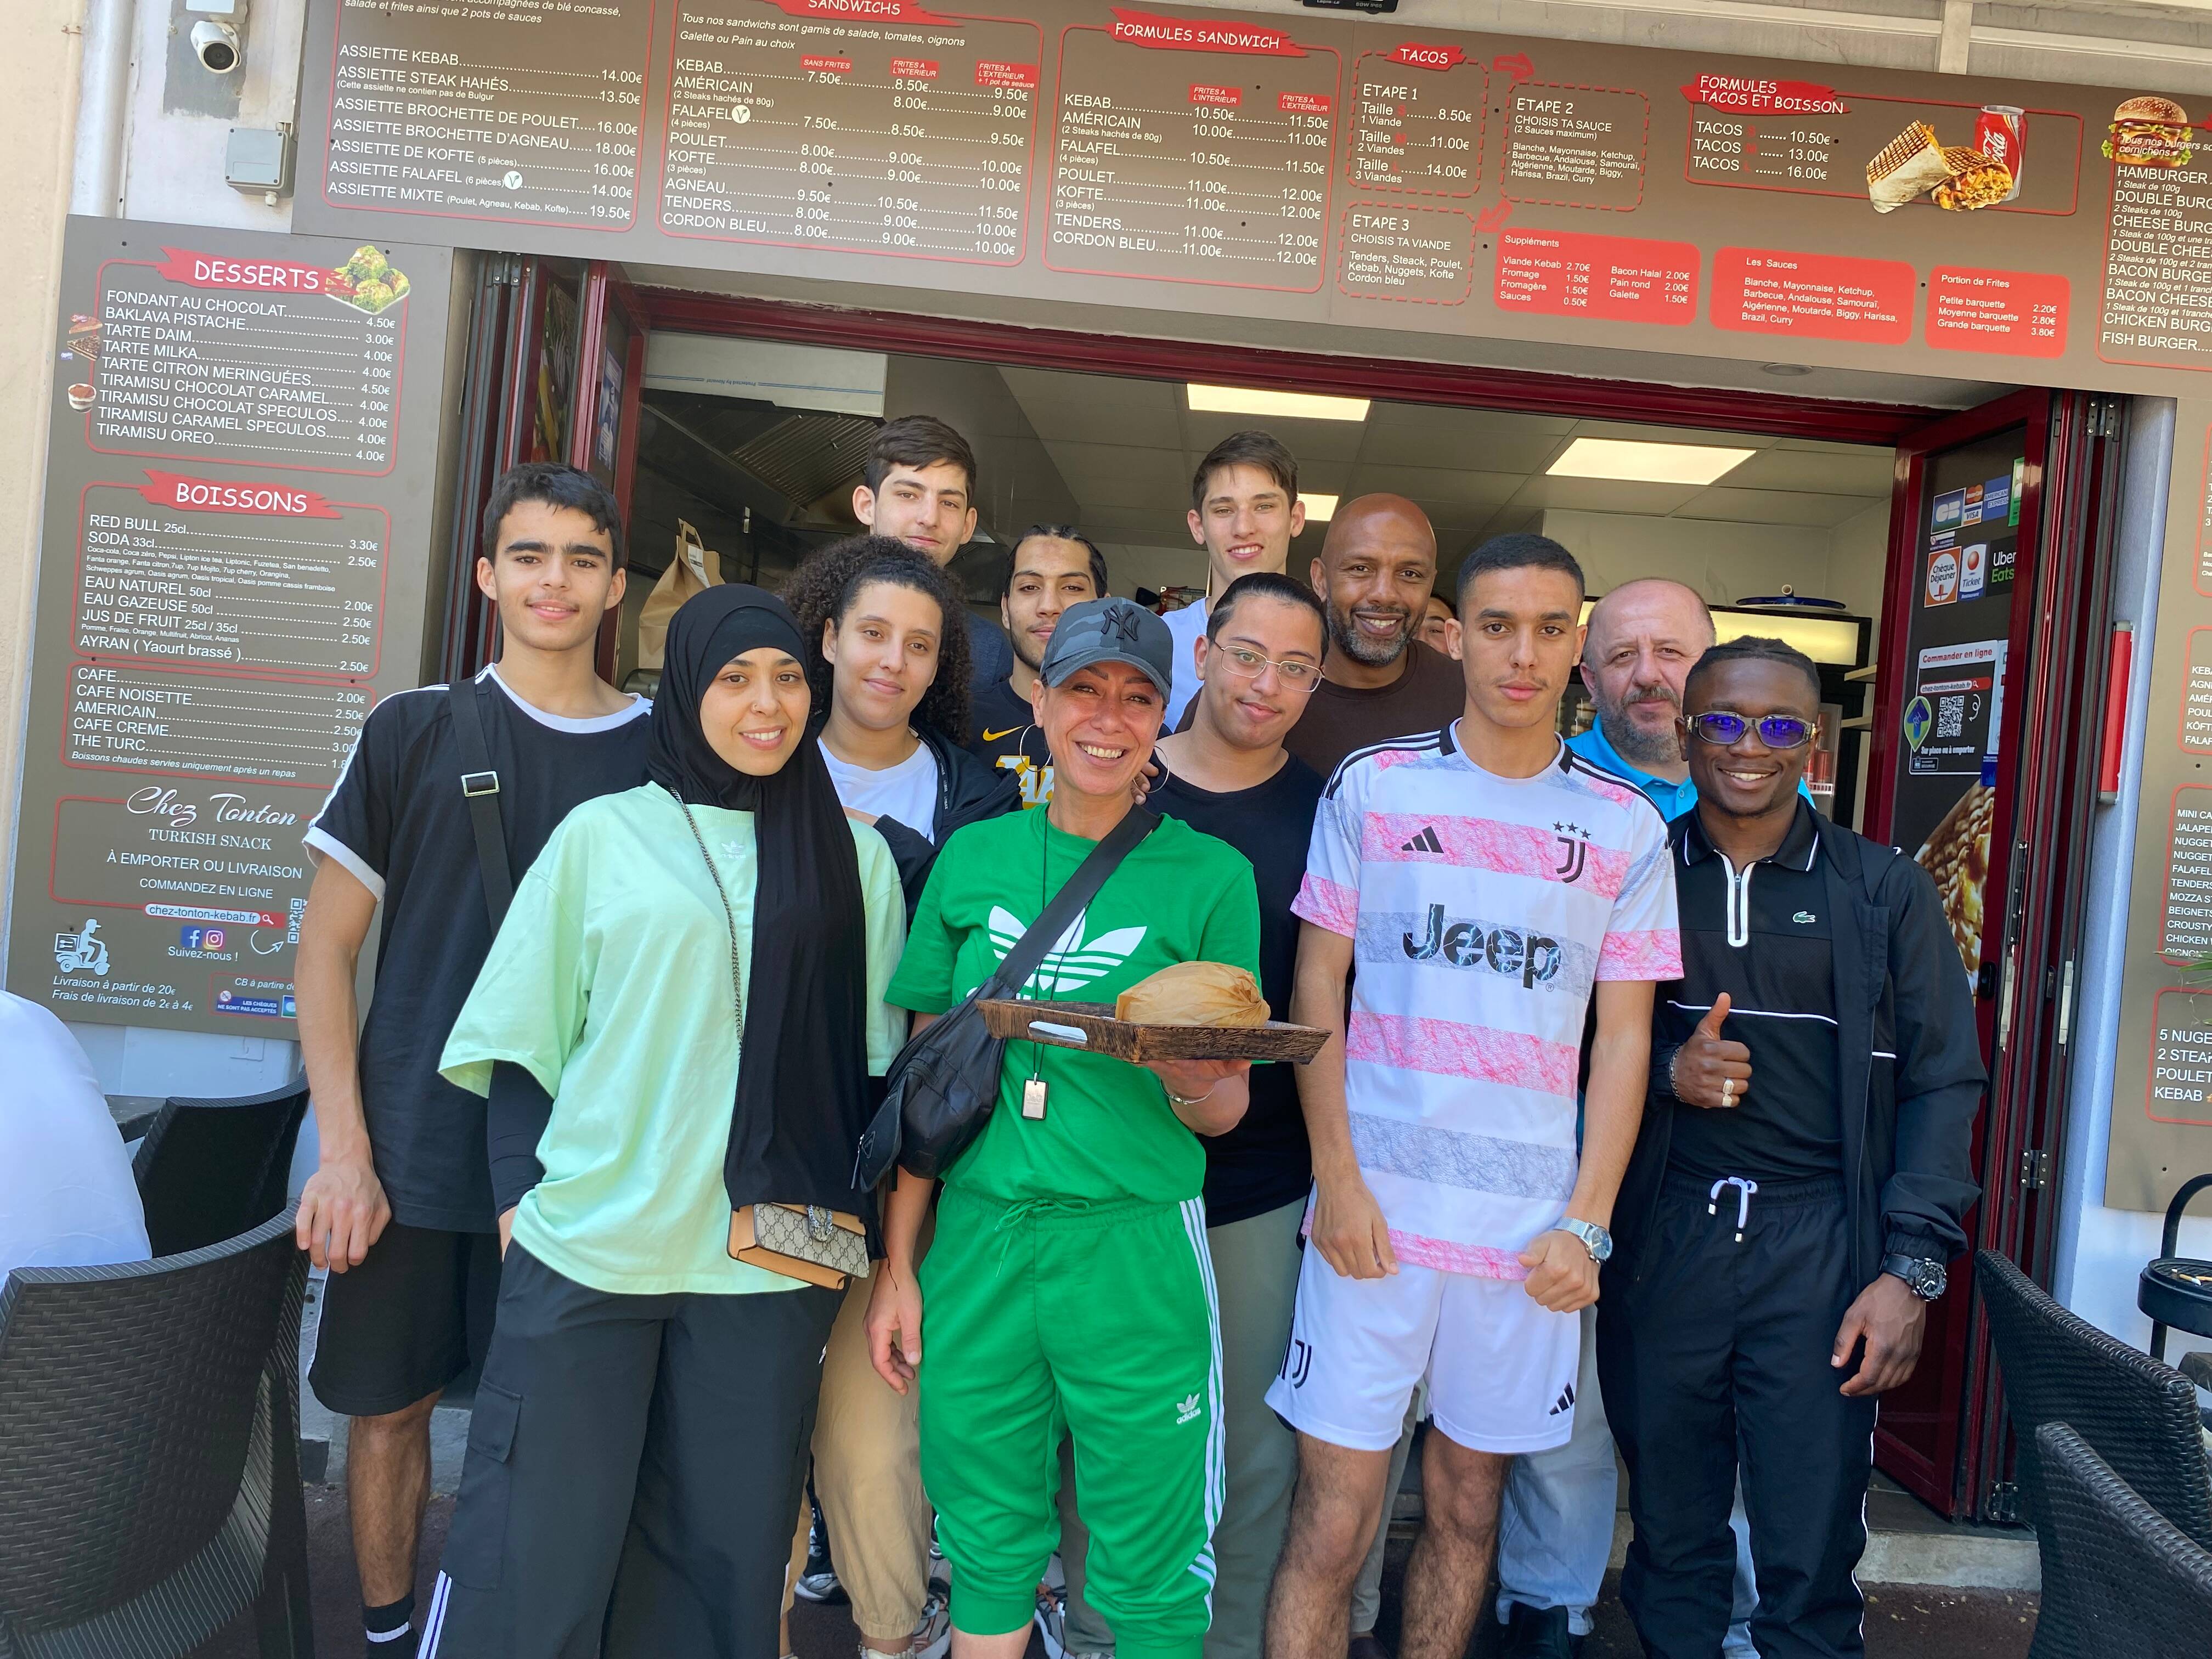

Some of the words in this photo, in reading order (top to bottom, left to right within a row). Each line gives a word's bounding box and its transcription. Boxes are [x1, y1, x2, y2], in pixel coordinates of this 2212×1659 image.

[682, 13, 704, 24] Tous
[706, 17, 724, 25] nos
[726, 19, 776, 30] sandwichs
[778, 24, 799, 32] sont
[833, 26, 845, 36] de
[847, 29, 881, 40] salade,
[884, 31, 924, 44] tomates,
[927, 36, 966, 46] oignons
[1115, 22, 1193, 41] FORMULES
[1197, 31, 1279, 49] SANDWICH
[339, 44, 408, 61] ASSIETTE
[412, 50, 459, 65] KEBAB
[602, 69, 642, 84] 14.00€
[803, 59, 823, 67] SANS
[825, 61, 851, 69] FRITES
[1400, 48, 1448, 64] TACOS
[410, 71, 456, 87] STEAK
[674, 75, 753, 94] AMÉRICAIN
[1700, 75, 1777, 94] FORMULES
[337, 80, 362, 89] (Cette
[364, 83, 394, 92] assiette
[408, 87, 437, 95] contien
[455, 90, 466, 98] de
[468, 91, 494, 102] Bulgur
[1363, 83, 1408, 100] ETAPE
[1412, 88, 1417, 100] 1
[1699, 89, 1747, 105] TACOS
[1752, 94, 1771, 107] ET
[1774, 96, 1843, 114] BOISSON
[1062, 110, 1141, 129] AMÉRICAIN
[1362, 101, 1393, 116] Taille
[1438, 108, 1472, 122] 8.50€
[1515, 115, 1559, 127] CHOISIS
[1561, 119, 1574, 129] TA
[1576, 120, 1612, 132] SAUCE
[1062, 125, 1070, 135] (2
[1072, 126, 1099, 136] Steaks
[1101, 129, 1130, 139] hachés
[1132, 132, 1142, 140] de
[1144, 132, 1163, 143] 80g)
[596, 142, 636, 156] 18.00€
[1694, 138, 1741, 154] TACOS
[1788, 148, 1829, 162] 13.00€
[1190, 151, 1231, 166] 10.50€
[2117, 165, 2208, 184] HAMBURGER
[2123, 180, 2147, 189] Steak
[2148, 183, 2159, 191] de
[2162, 183, 2181, 194] 100g
[400, 187, 444, 202] MIXTE
[447, 195, 477, 206] (Poulet,
[478, 198, 512, 210] Agneau,
[514, 201, 542, 212] Kebab,
[590, 205, 631, 220] 19.50€
[1352, 214, 1398, 230] ETAPE
[1401, 219, 1409, 231] 3
[1053, 231, 1115, 247] CORDON
[1504, 235, 1559, 247] Suppléments
[1350, 251, 1390, 264] Tenders,
[1392, 255, 1427, 268] Steack,
[1430, 258, 1463, 270] Poulet,
[1503, 256, 1532, 266] Viande
[1534, 258, 1562, 269] Kebab
[1566, 262, 1590, 272] 2.70€
[1746, 257, 1762, 267] Les
[1766, 259, 1798, 269] Sauces
[194, 259, 319, 290] DESSERTS
[1611, 266, 1638, 276] Bacon
[1640, 268, 1662, 278] Halal
[1941, 274, 1971, 285] Portion
[1973, 277, 1984, 286] de
[1986, 278, 2010, 288] Frites
[1609, 289, 1640, 300] Galette
[1664, 294, 1688, 304] 1.50€
[107, 290, 179, 307] FONDANT
[181, 296, 201, 309] AU
[205, 298, 286, 317] CHOCOLAT
[366, 317, 396, 329] 4.50€
[1937, 318, 1968, 329] Grande
[1971, 321, 2011, 332] barquette
[2031, 327, 2055, 337] 3.80€
[2102, 331, 2134, 345] FISH
[2138, 334, 2198, 351] BURGER
[153, 360, 208, 377] CITRON
[213, 366, 311, 386] MERINGUÉES
[97, 422, 167, 441] TIRAMISU
[171, 429, 214, 444] OREO
[356, 450, 385, 461] 4.00€
[176, 483, 307, 513] BOISSONS
[1984, 491, 2008, 501] AMERICAN
[1967, 511, 1979, 520] VISA
[90, 514, 121, 528] RED
[125, 517, 161, 532] BULL
[163, 523, 186, 534] 25cl
[349, 539, 378, 551] 3.30€
[1993, 551, 2016, 566] Uber
[1963, 578, 1980, 588] Ticket
[1991, 567, 2015, 583] Eats
[142, 640, 185, 655] Yaourt
[188, 644, 232, 659] brassé
[1923, 651, 1962, 663] Commander
[1975, 648, 1993, 658] ligne
[76, 684, 116, 699] CAFE
[119, 687, 193, 705] NOISETTE
[71, 751, 110, 762] Boissons
[112, 754, 148, 765] chaudes
[150, 759, 180, 768] servies
[182, 762, 232, 772] uniquement
[233, 766, 258, 775] après
[272, 770, 296, 778] repas
[127, 786, 198, 827] Chez
[210, 793, 298, 826] Tonton
[2177, 809, 2197, 819] MINI
[149, 828, 217, 845] TURKISH
[220, 834, 272, 850] SNACK
[106, 849, 117, 863] À
[120, 853, 199, 870] EMPORTER
[204, 860, 224, 872] OU
[228, 861, 302, 879] LIVRAISON
[139, 878, 217, 894] COMMANDEZ
[219, 884, 235, 895] EN
[238, 886, 274, 899] LIGNE
[2170, 893, 2202, 903] MOZZA
[150, 905, 256, 923] chez-tonton-kebab.fr
[1403, 903, 1561, 989] Jeep
[2166, 934, 2208, 945] CHICKEN
[168, 945, 232, 961] Suivez-nous
[53, 975, 100, 988] Livraison
[103, 979, 110, 989] à
[111, 982, 140, 992] partir
[142, 983, 155, 994] de
[157, 984, 176, 995] 20€
[235, 978, 247, 986] CB
[257, 981, 284, 990] partire
[2154, 1087, 2203, 1103] KEBAB
[1176, 1407, 1201, 1425] adidas
